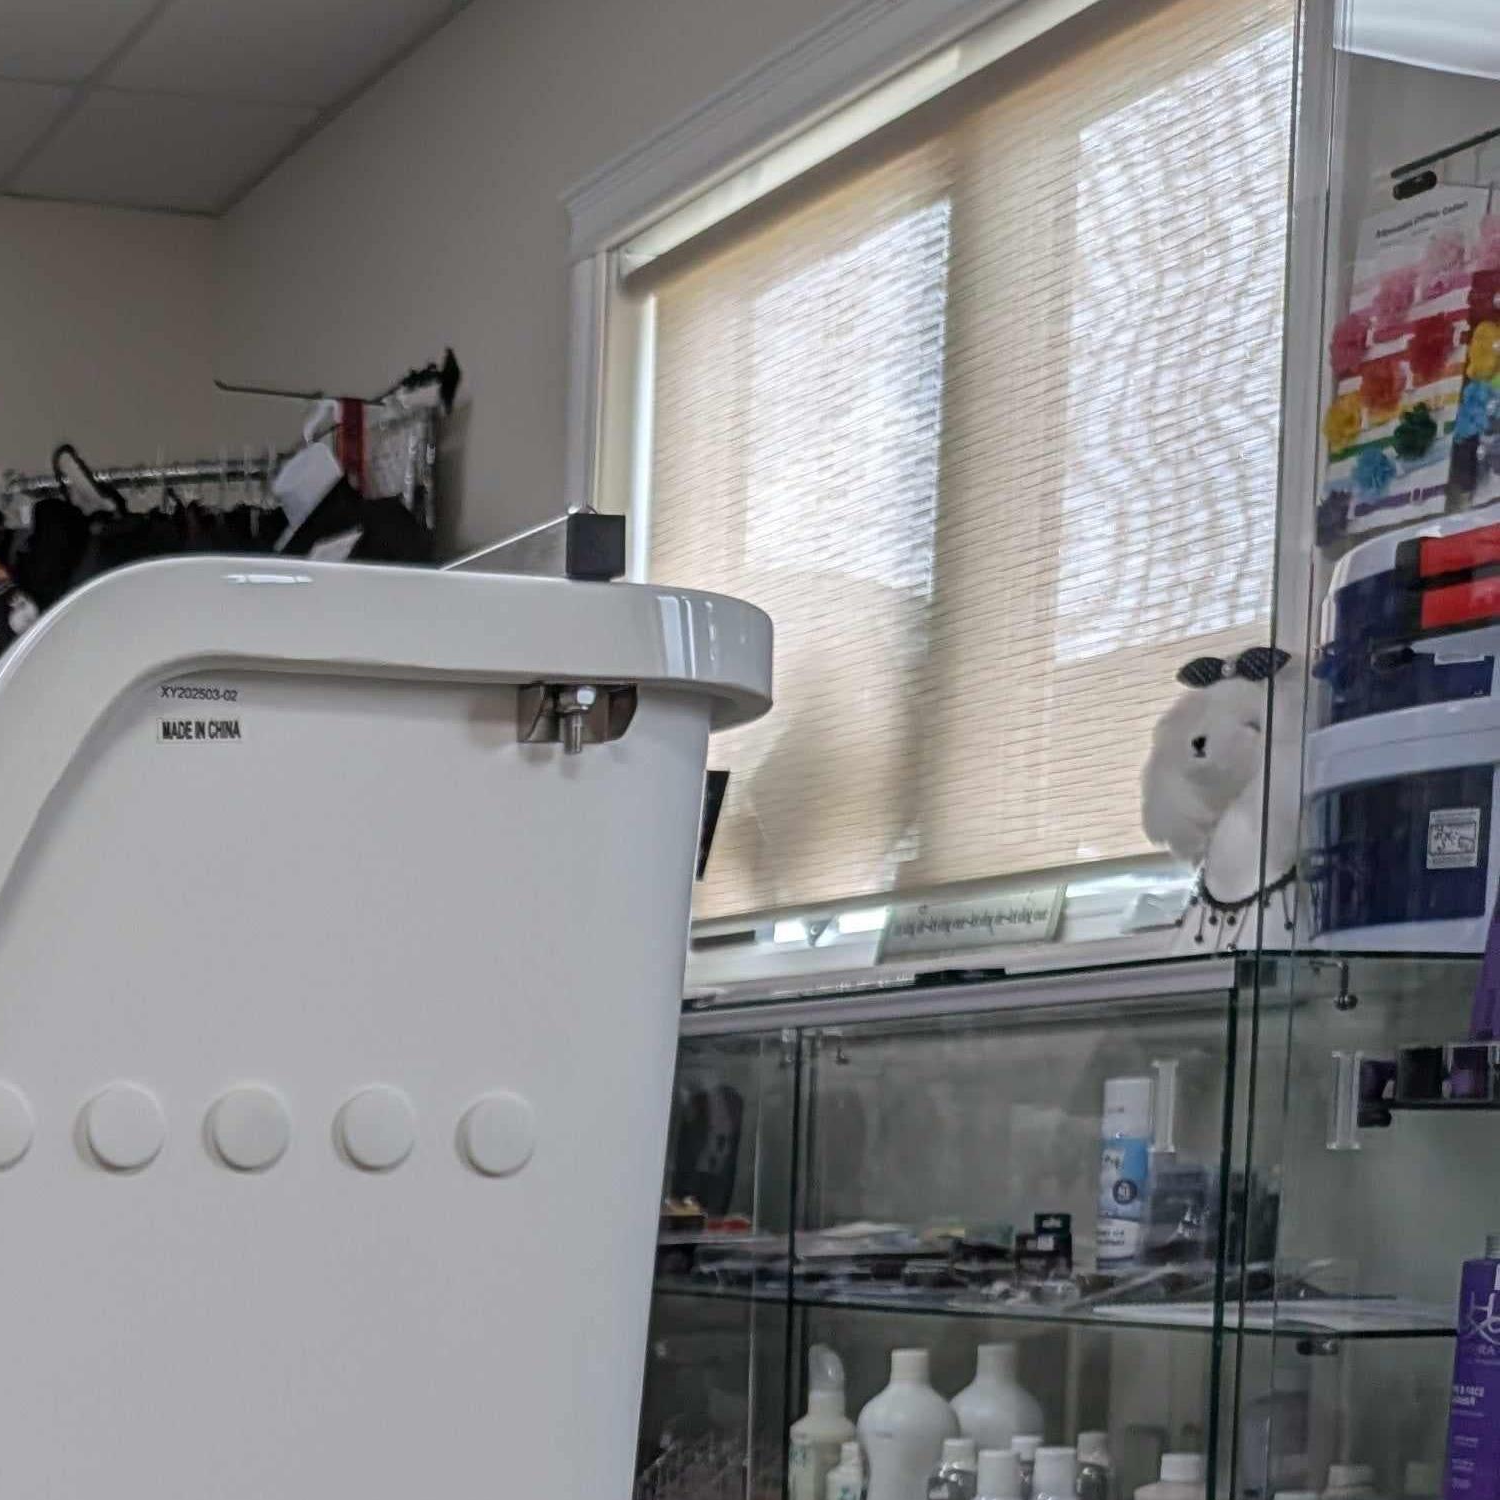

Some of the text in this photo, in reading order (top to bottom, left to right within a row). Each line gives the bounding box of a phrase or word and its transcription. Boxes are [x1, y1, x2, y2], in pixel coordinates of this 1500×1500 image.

[162, 720, 242, 740] MADE IN CHINA
